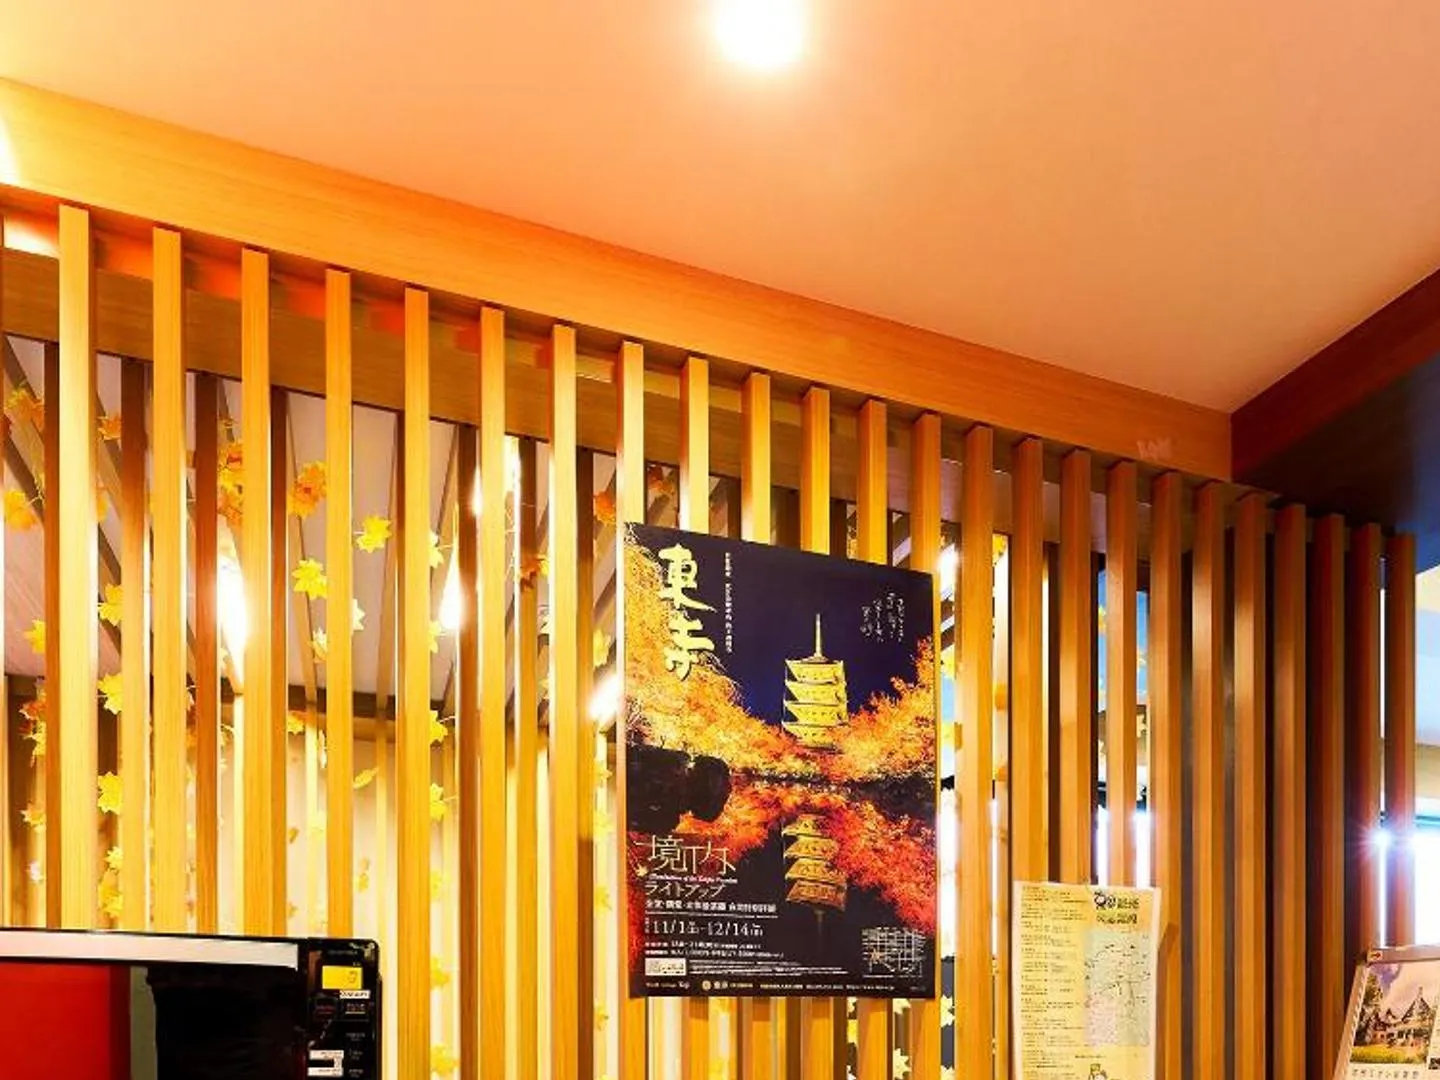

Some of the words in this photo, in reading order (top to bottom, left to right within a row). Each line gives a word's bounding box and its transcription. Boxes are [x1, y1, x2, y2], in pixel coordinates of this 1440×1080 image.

[658, 543, 717, 682] 東寺
[645, 881, 726, 898] ライトアップ
